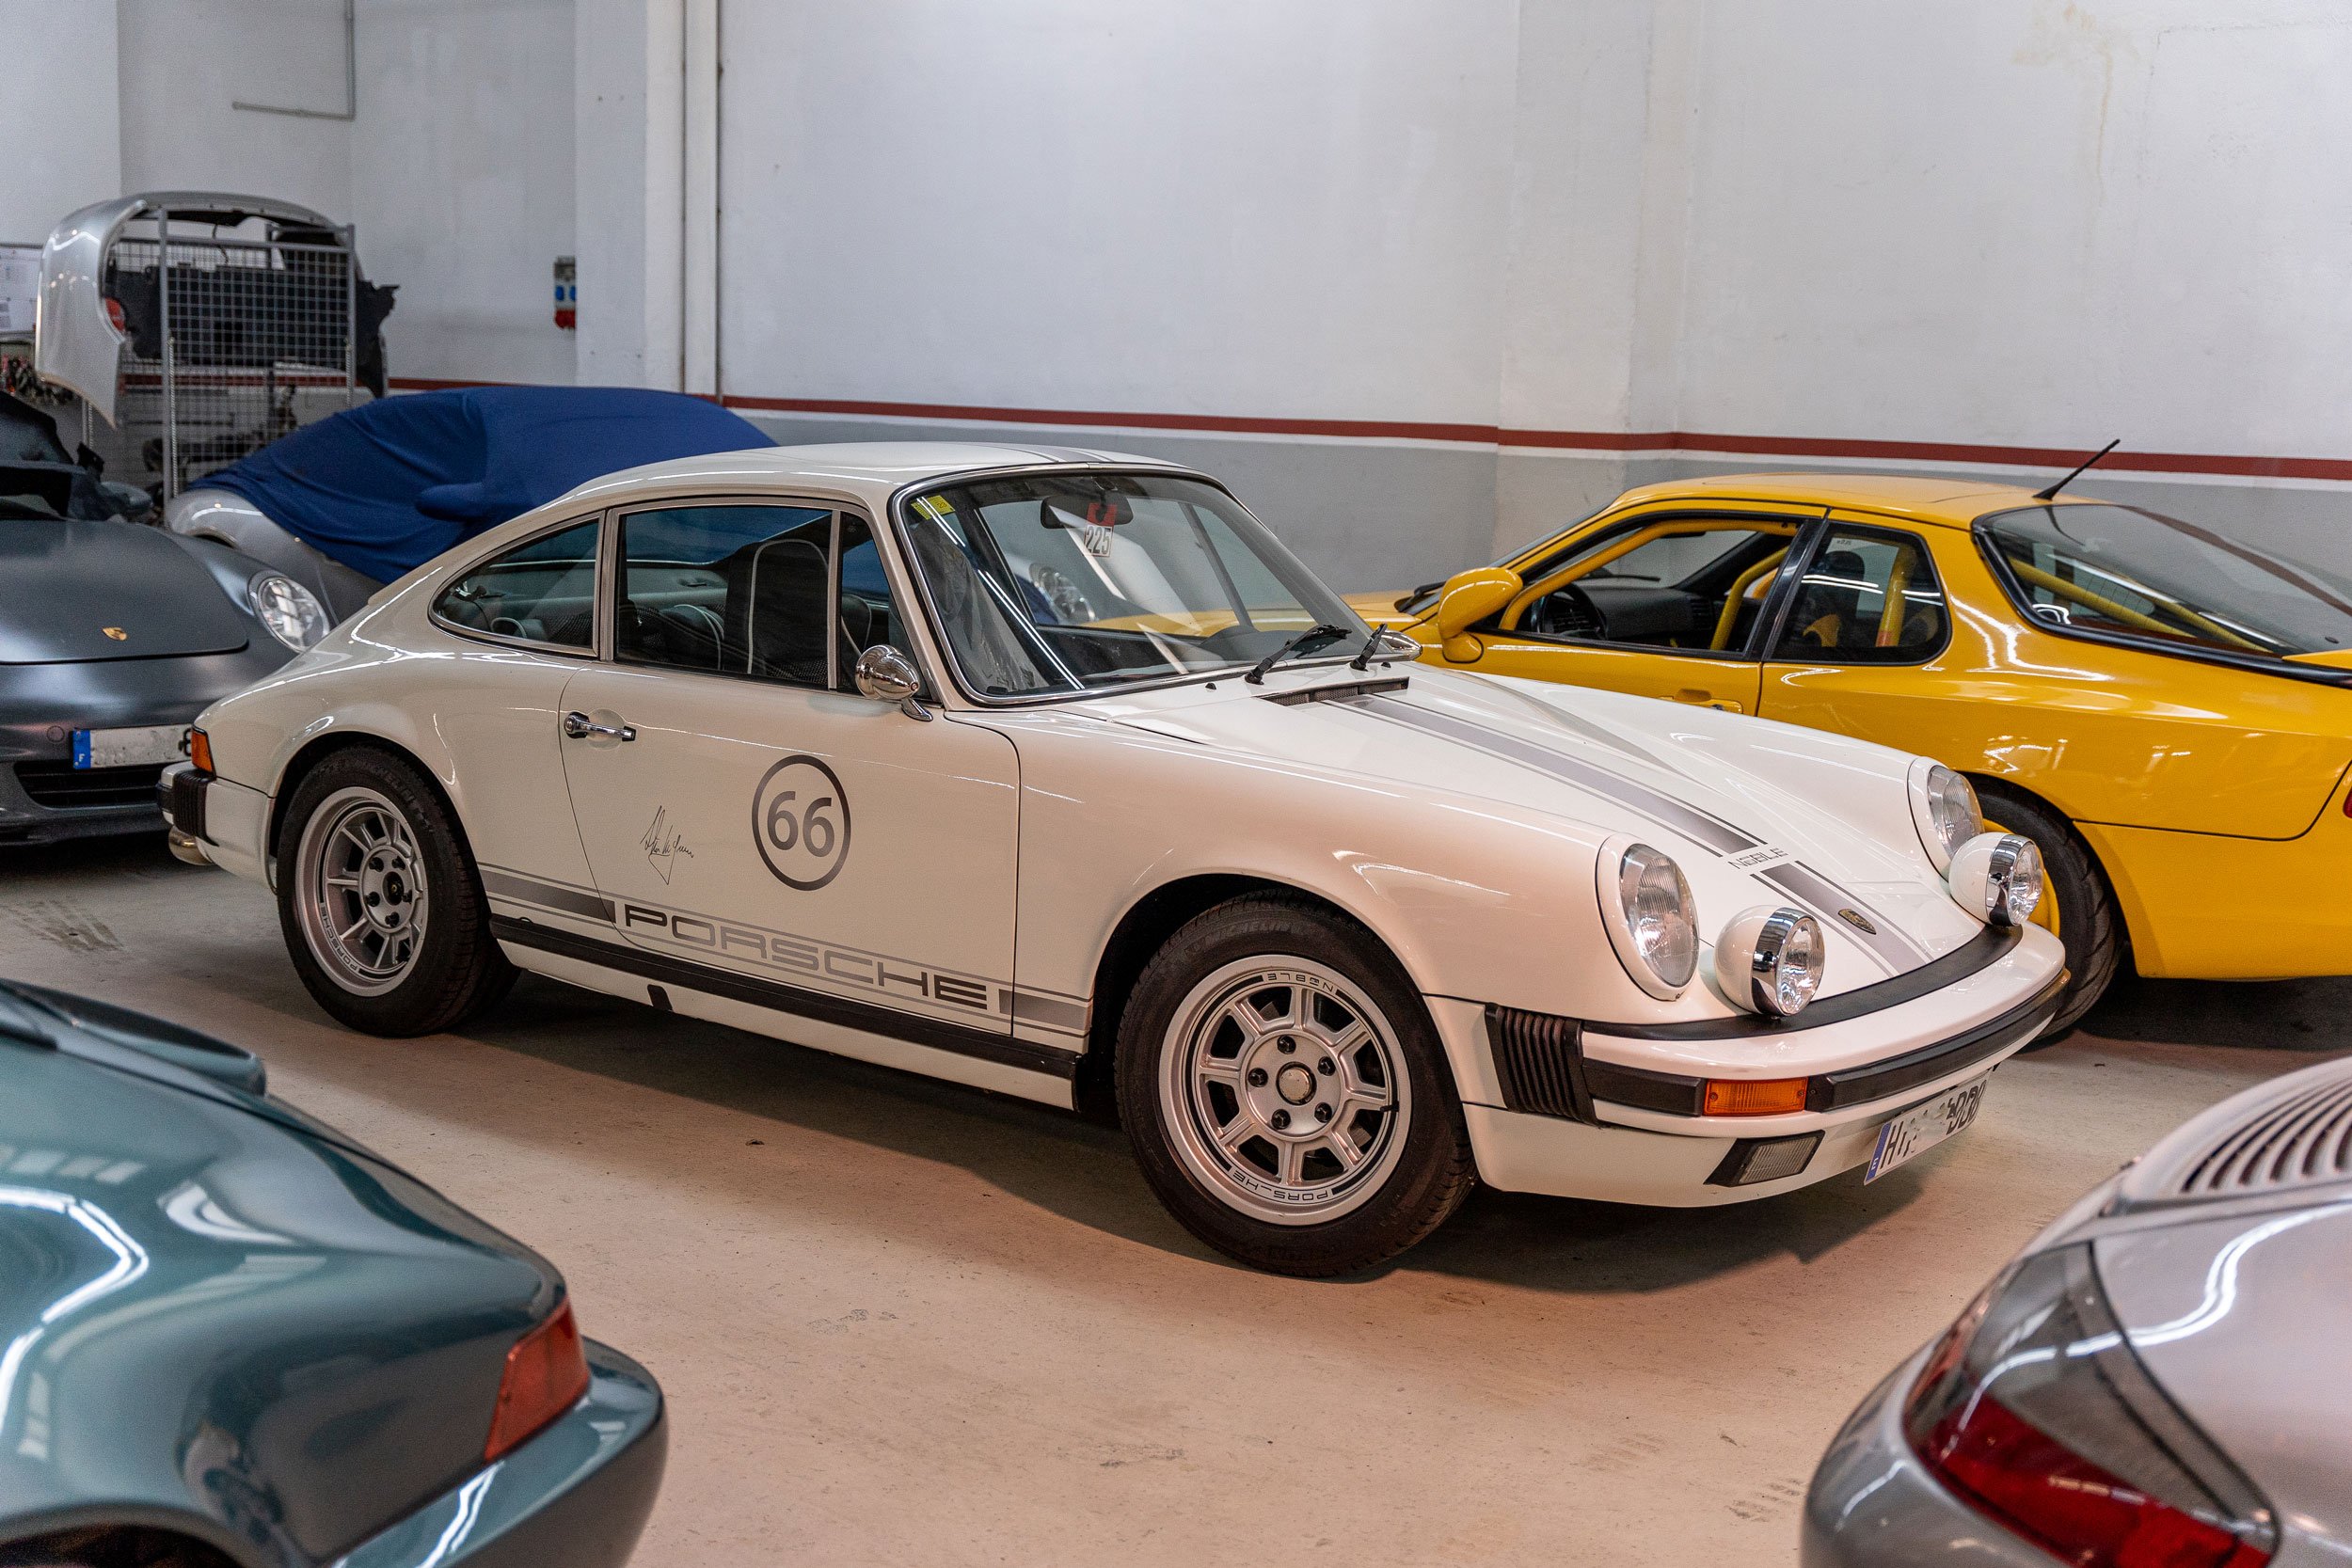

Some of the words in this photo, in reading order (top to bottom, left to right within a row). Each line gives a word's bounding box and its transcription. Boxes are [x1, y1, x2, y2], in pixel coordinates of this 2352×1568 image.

[1086, 526, 1111, 555] 225
[768, 791, 835, 857] 66
[625, 904, 988, 1010] PORSCHE
[1232, 1170, 1328, 1201] PORSHE
